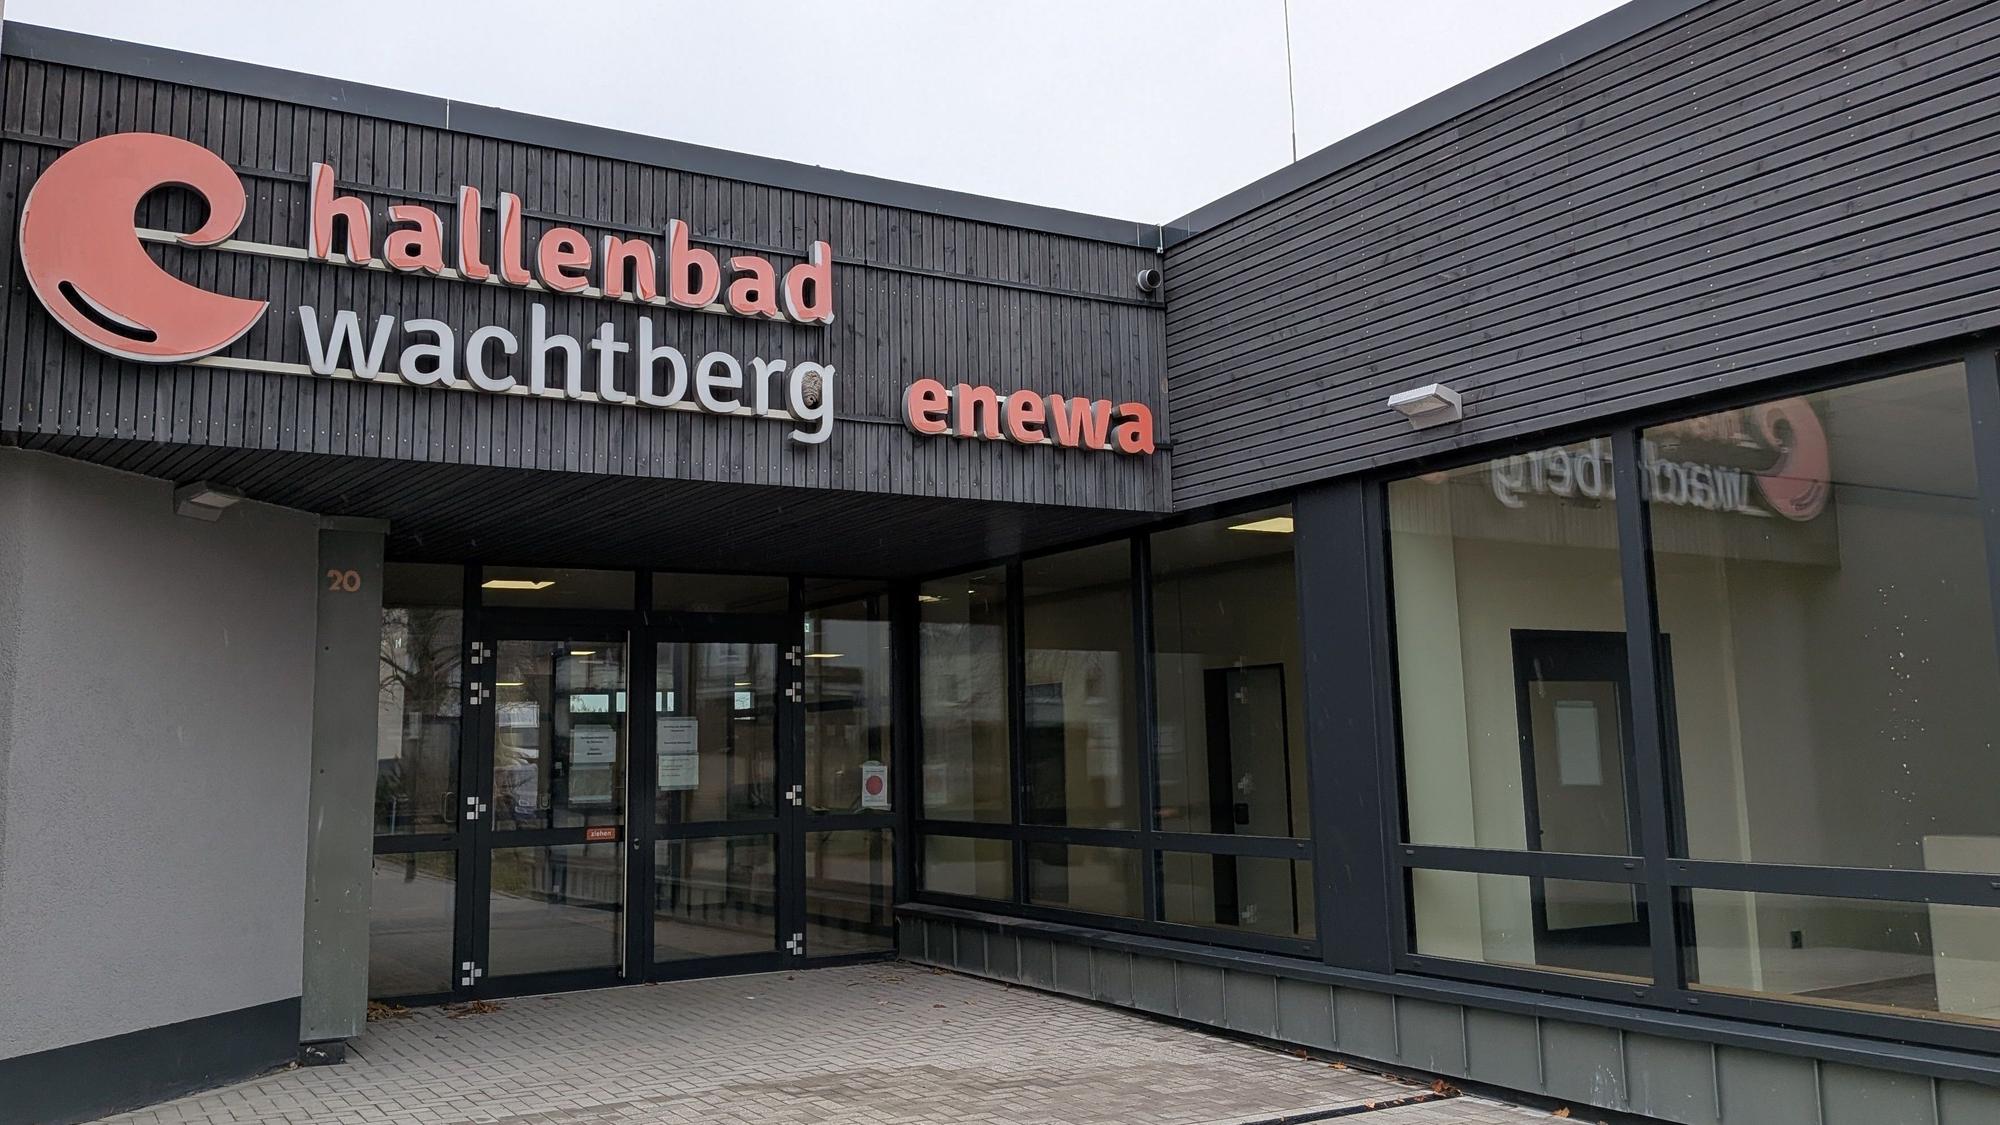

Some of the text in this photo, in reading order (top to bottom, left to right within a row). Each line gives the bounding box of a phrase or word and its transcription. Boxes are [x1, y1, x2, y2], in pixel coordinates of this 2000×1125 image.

[308, 162, 835, 327] hallenbad
[298, 302, 836, 445] wachtberg
[902, 378, 1155, 454] enewa
[327, 569, 361, 592] 20
